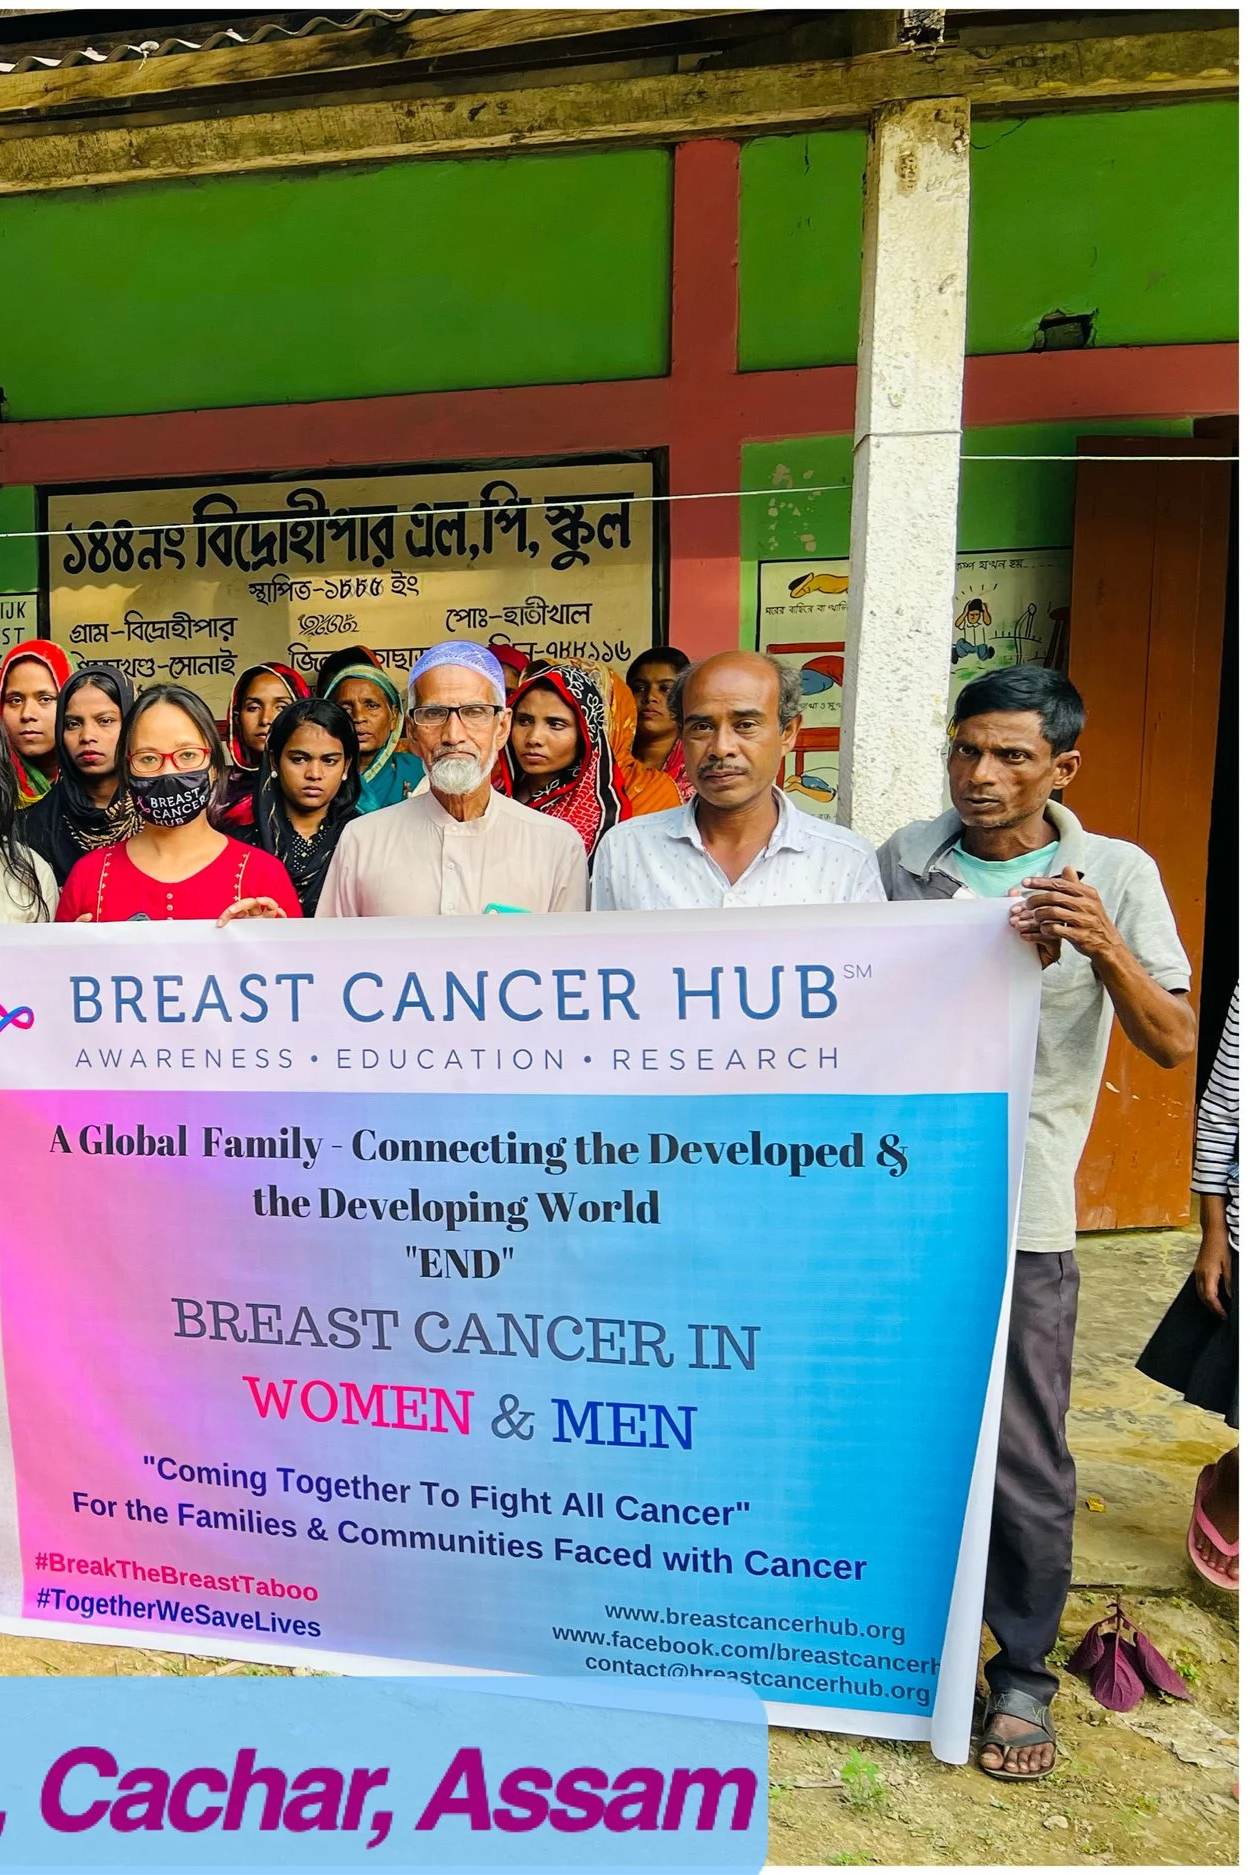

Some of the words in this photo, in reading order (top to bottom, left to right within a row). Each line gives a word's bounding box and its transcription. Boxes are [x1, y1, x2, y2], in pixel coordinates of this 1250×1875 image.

[150, 787, 201, 809] BREAST
[152, 795, 207, 819] CANCER
[69, 972, 314, 1024] BREAST
[343, 968, 640, 1023] CANCER
[672, 964, 838, 1020] HUB
[75, 1048, 293, 1069] AWARENESS
[337, 1048, 564, 1070] EDUCATION
[613, 1047, 839, 1070] RESEARCH
[49, 1125, 72, 1154] A
[79, 1124, 188, 1157] Global
[202, 1126, 324, 1170] Family
[351, 1129, 567, 1176] Connecting
[574, 1131, 639, 1165] the
[647, 1130, 865, 1178] Developed
[876, 1133, 908, 1178] &
[252, 1184, 310, 1218] the
[318, 1187, 529, 1232] Developing
[535, 1190, 661, 1224] World
[405, 1245, 515, 1280] "END"
[171, 1297, 399, 1351] BREAST
[413, 1311, 675, 1369] CANCER
[687, 1323, 762, 1371] IN
[242, 1375, 475, 1436] WOMEN
[491, 1393, 536, 1442] &
[550, 1398, 698, 1450] MEN
[143, 1454, 267, 1497] "Coming
[276, 1466, 411, 1503] Together
[420, 1481, 459, 1508] To
[470, 1484, 552, 1519] Fight
[562, 1492, 604, 1519] All
[615, 1495, 751, 1527] Cancer"
[72, 1491, 118, 1518] For
[125, 1499, 169, 1525] the
[178, 1503, 298, 1539] Families
[307, 1517, 330, 1542] &
[337, 1520, 544, 1561] Communities
[554, 1537, 652, 1570] Faced
[662, 1546, 734, 1575] with
[743, 1549, 868, 1581] Cancer
[35, 1552, 319, 1603] #BreakTheBreastTaboo
[36, 1587, 322, 1638] #TogetherWeSaveLives
[604, 1604, 906, 1646] www.breastcancerhub.org
